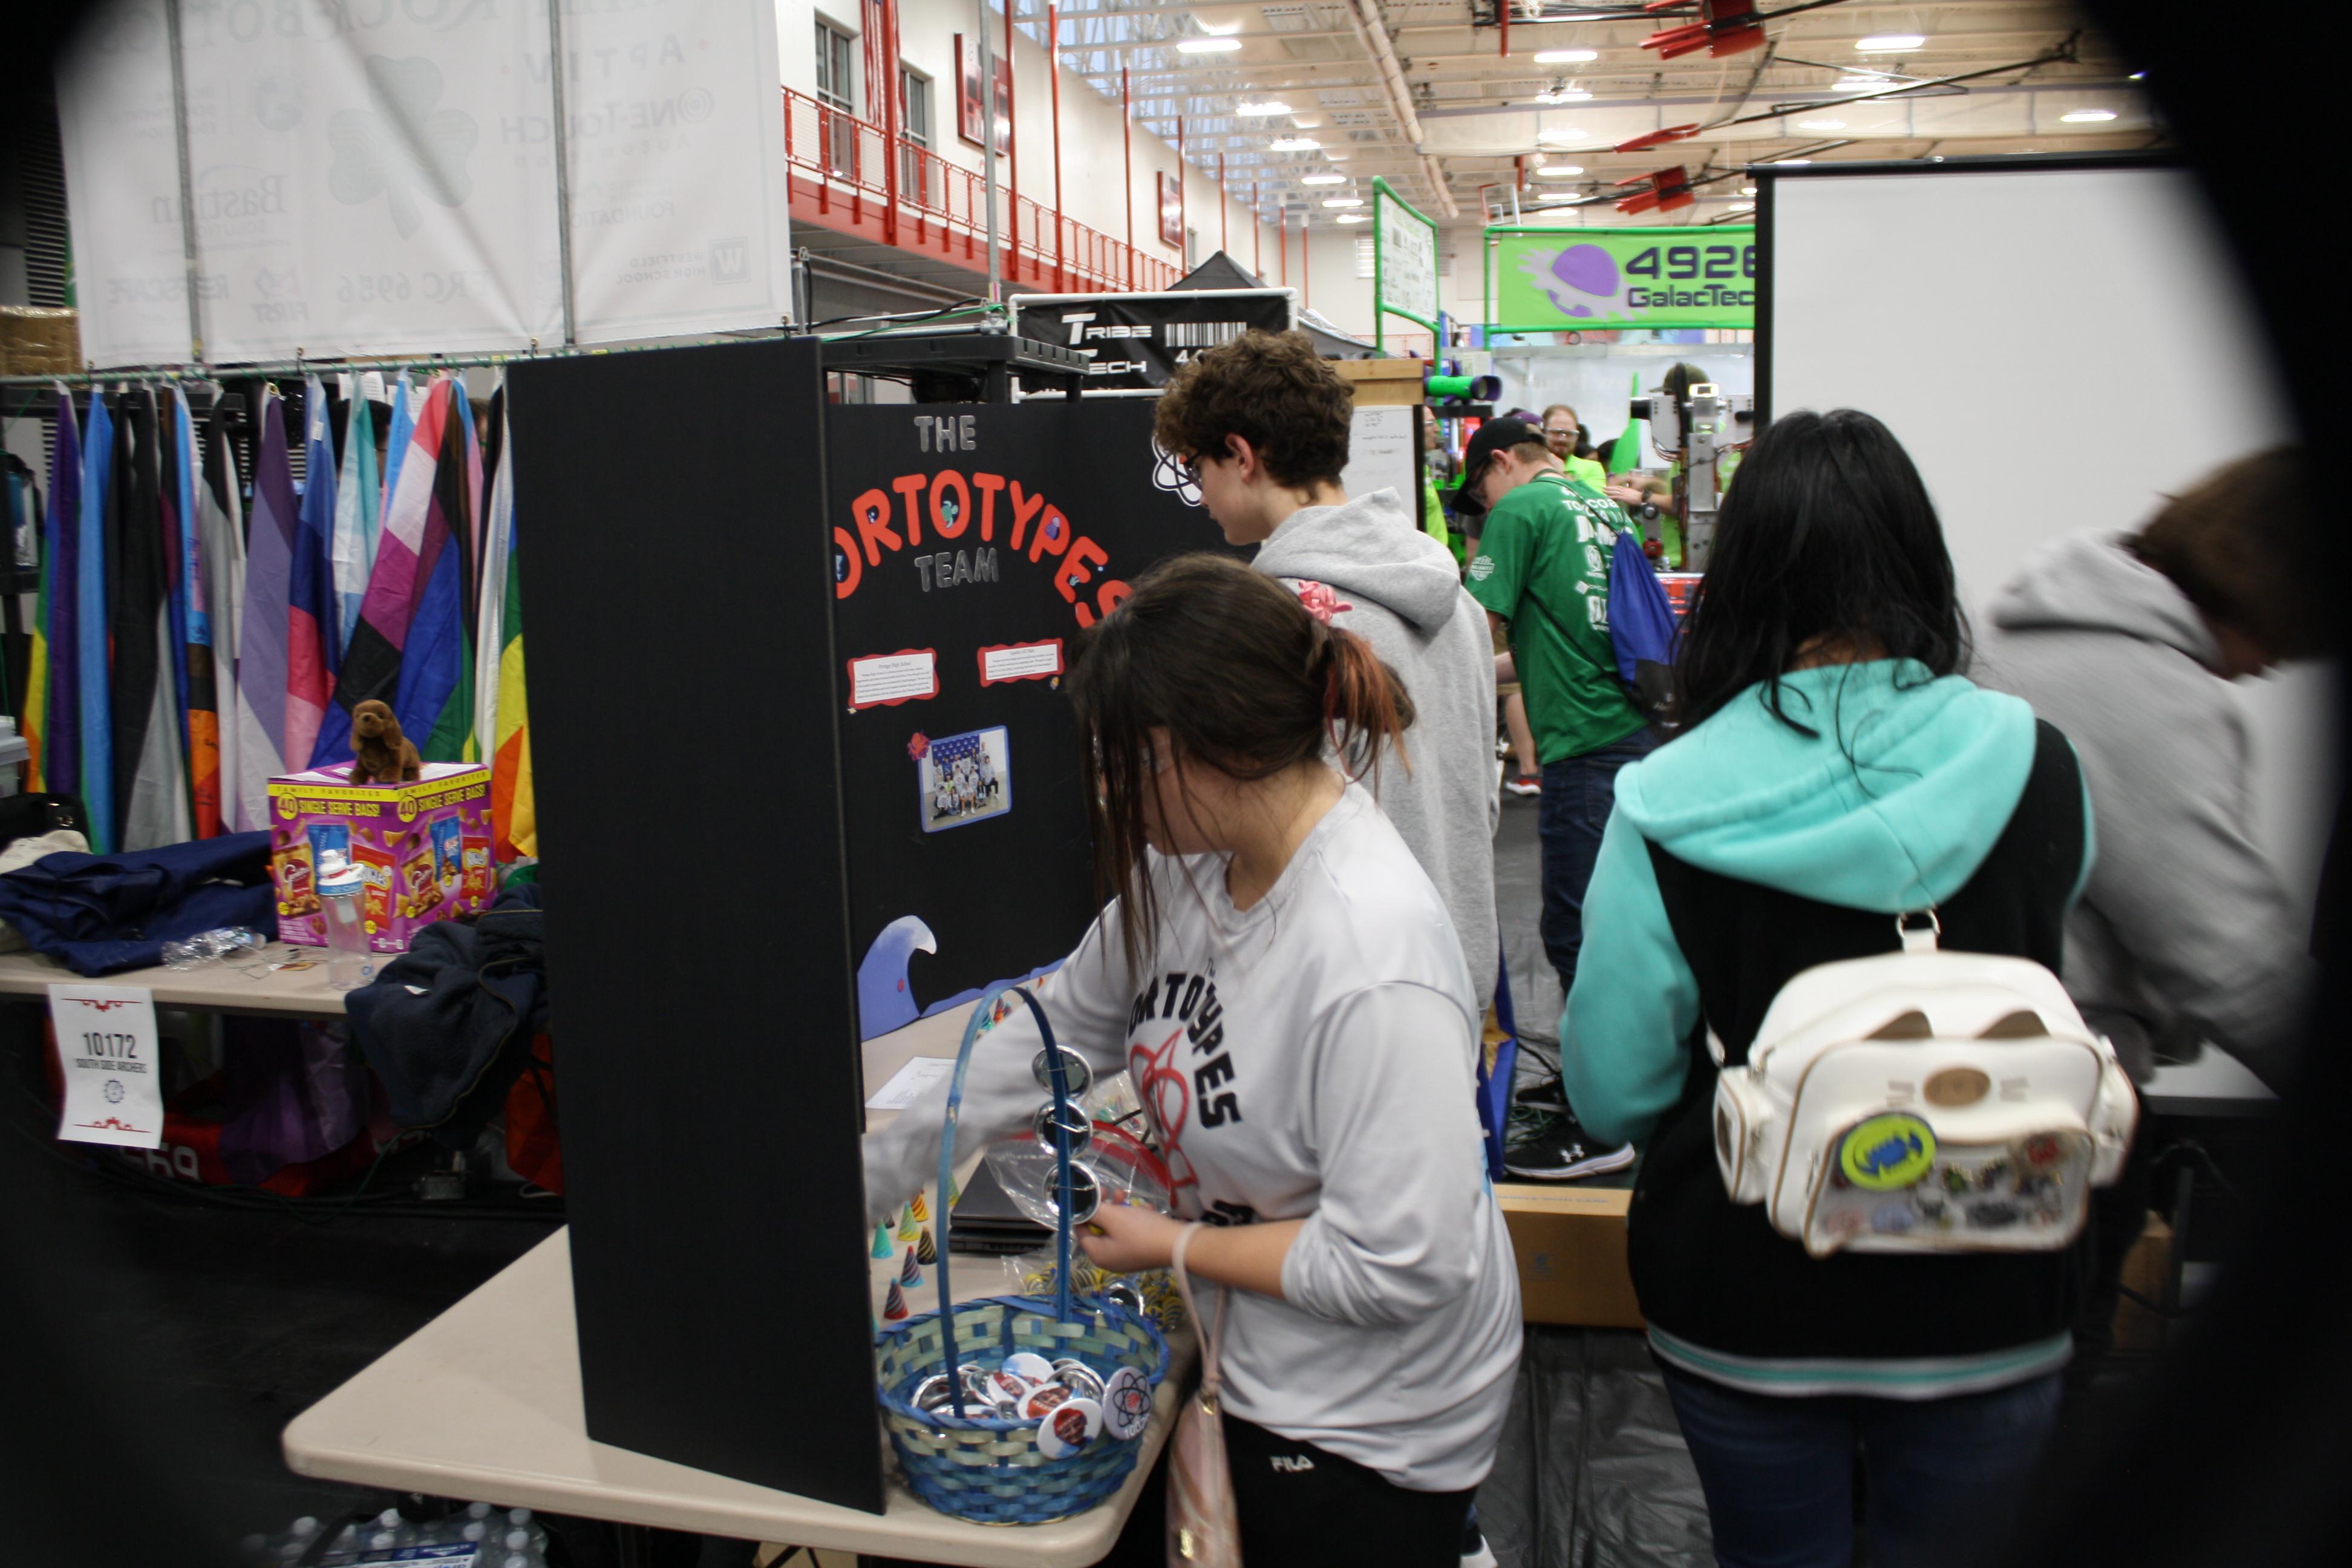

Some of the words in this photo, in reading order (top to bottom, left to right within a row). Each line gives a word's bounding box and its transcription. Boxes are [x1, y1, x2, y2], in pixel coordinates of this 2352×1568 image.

[1625, 245, 1755, 279] 4926
[1628, 284, 1755, 307] GalacTec
[914, 415, 976, 452] THE
[914, 547, 999, 592] TEAM
[279, 797, 295, 814] 40
[400, 800, 414, 816] 40
[83, 1032, 137, 1059] 10172
[1270, 1454, 1315, 1472] FILA
